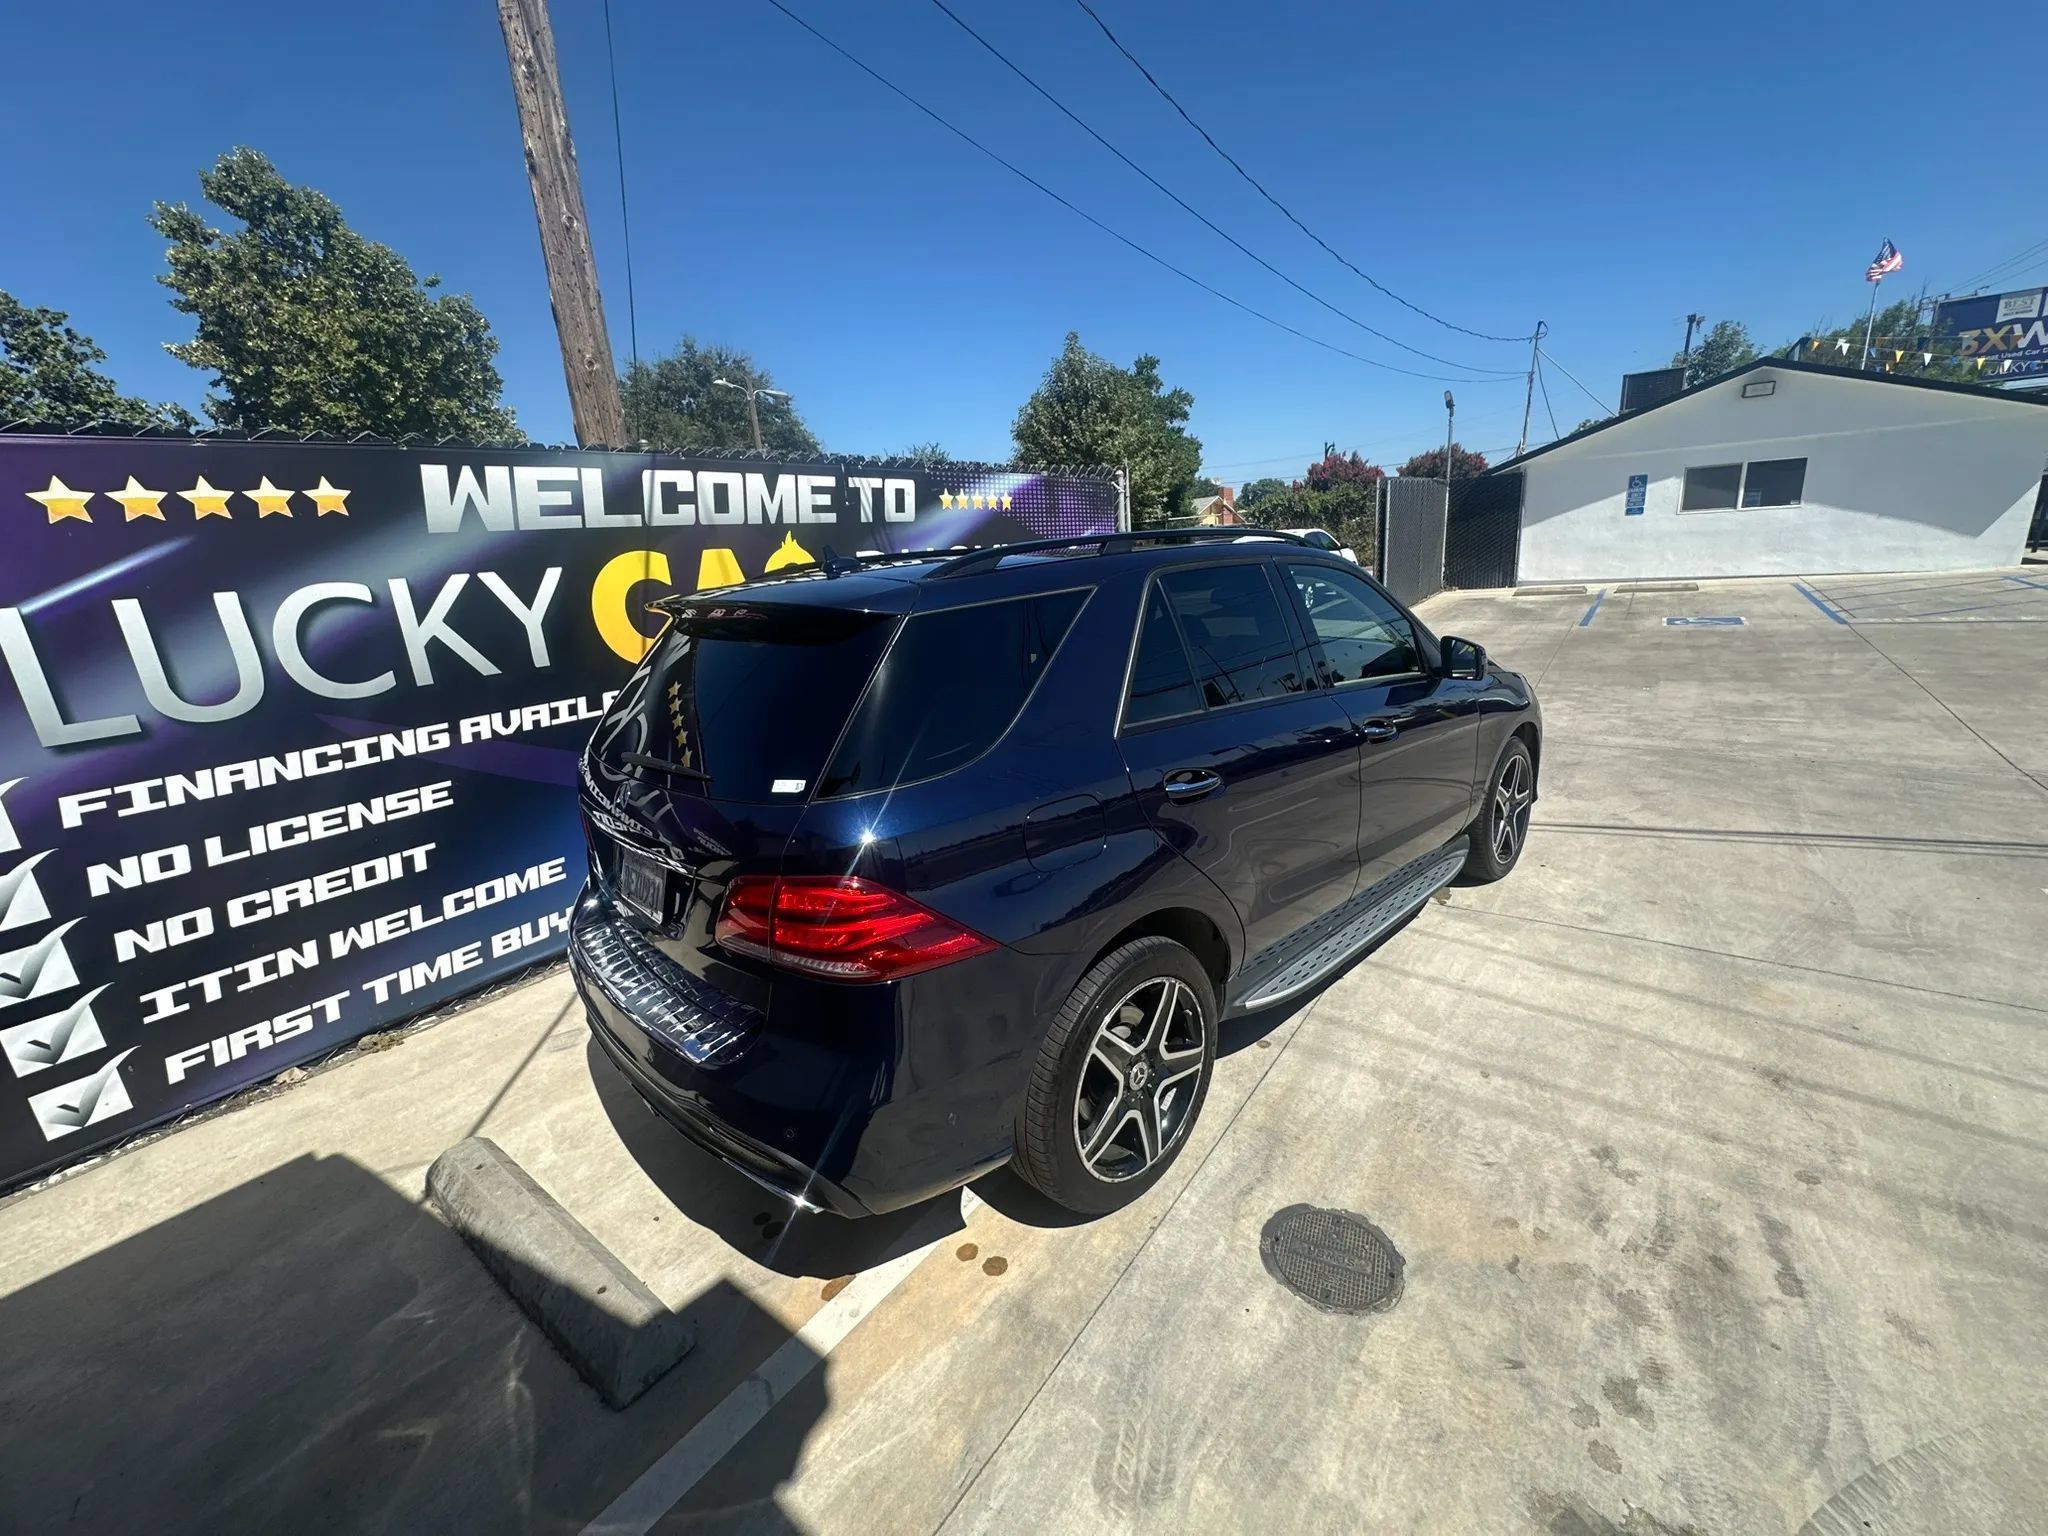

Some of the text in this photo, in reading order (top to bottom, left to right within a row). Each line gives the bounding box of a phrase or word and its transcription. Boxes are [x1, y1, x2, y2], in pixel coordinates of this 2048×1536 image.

[2001, 351, 2023, 359] Used
[420, 464, 916, 533] WELCOME TO
[0, 566, 563, 748] LUCKY
[58, 722, 451, 829] FINANCING
[86, 780, 453, 897] NO LICENSE
[114, 842, 436, 962] NO CREDIT
[139, 937, 320, 1024] ITIN
[329, 857, 566, 959] WELCOME
[164, 991, 352, 1085] FIRST
[362, 940, 481, 1003] TIME
